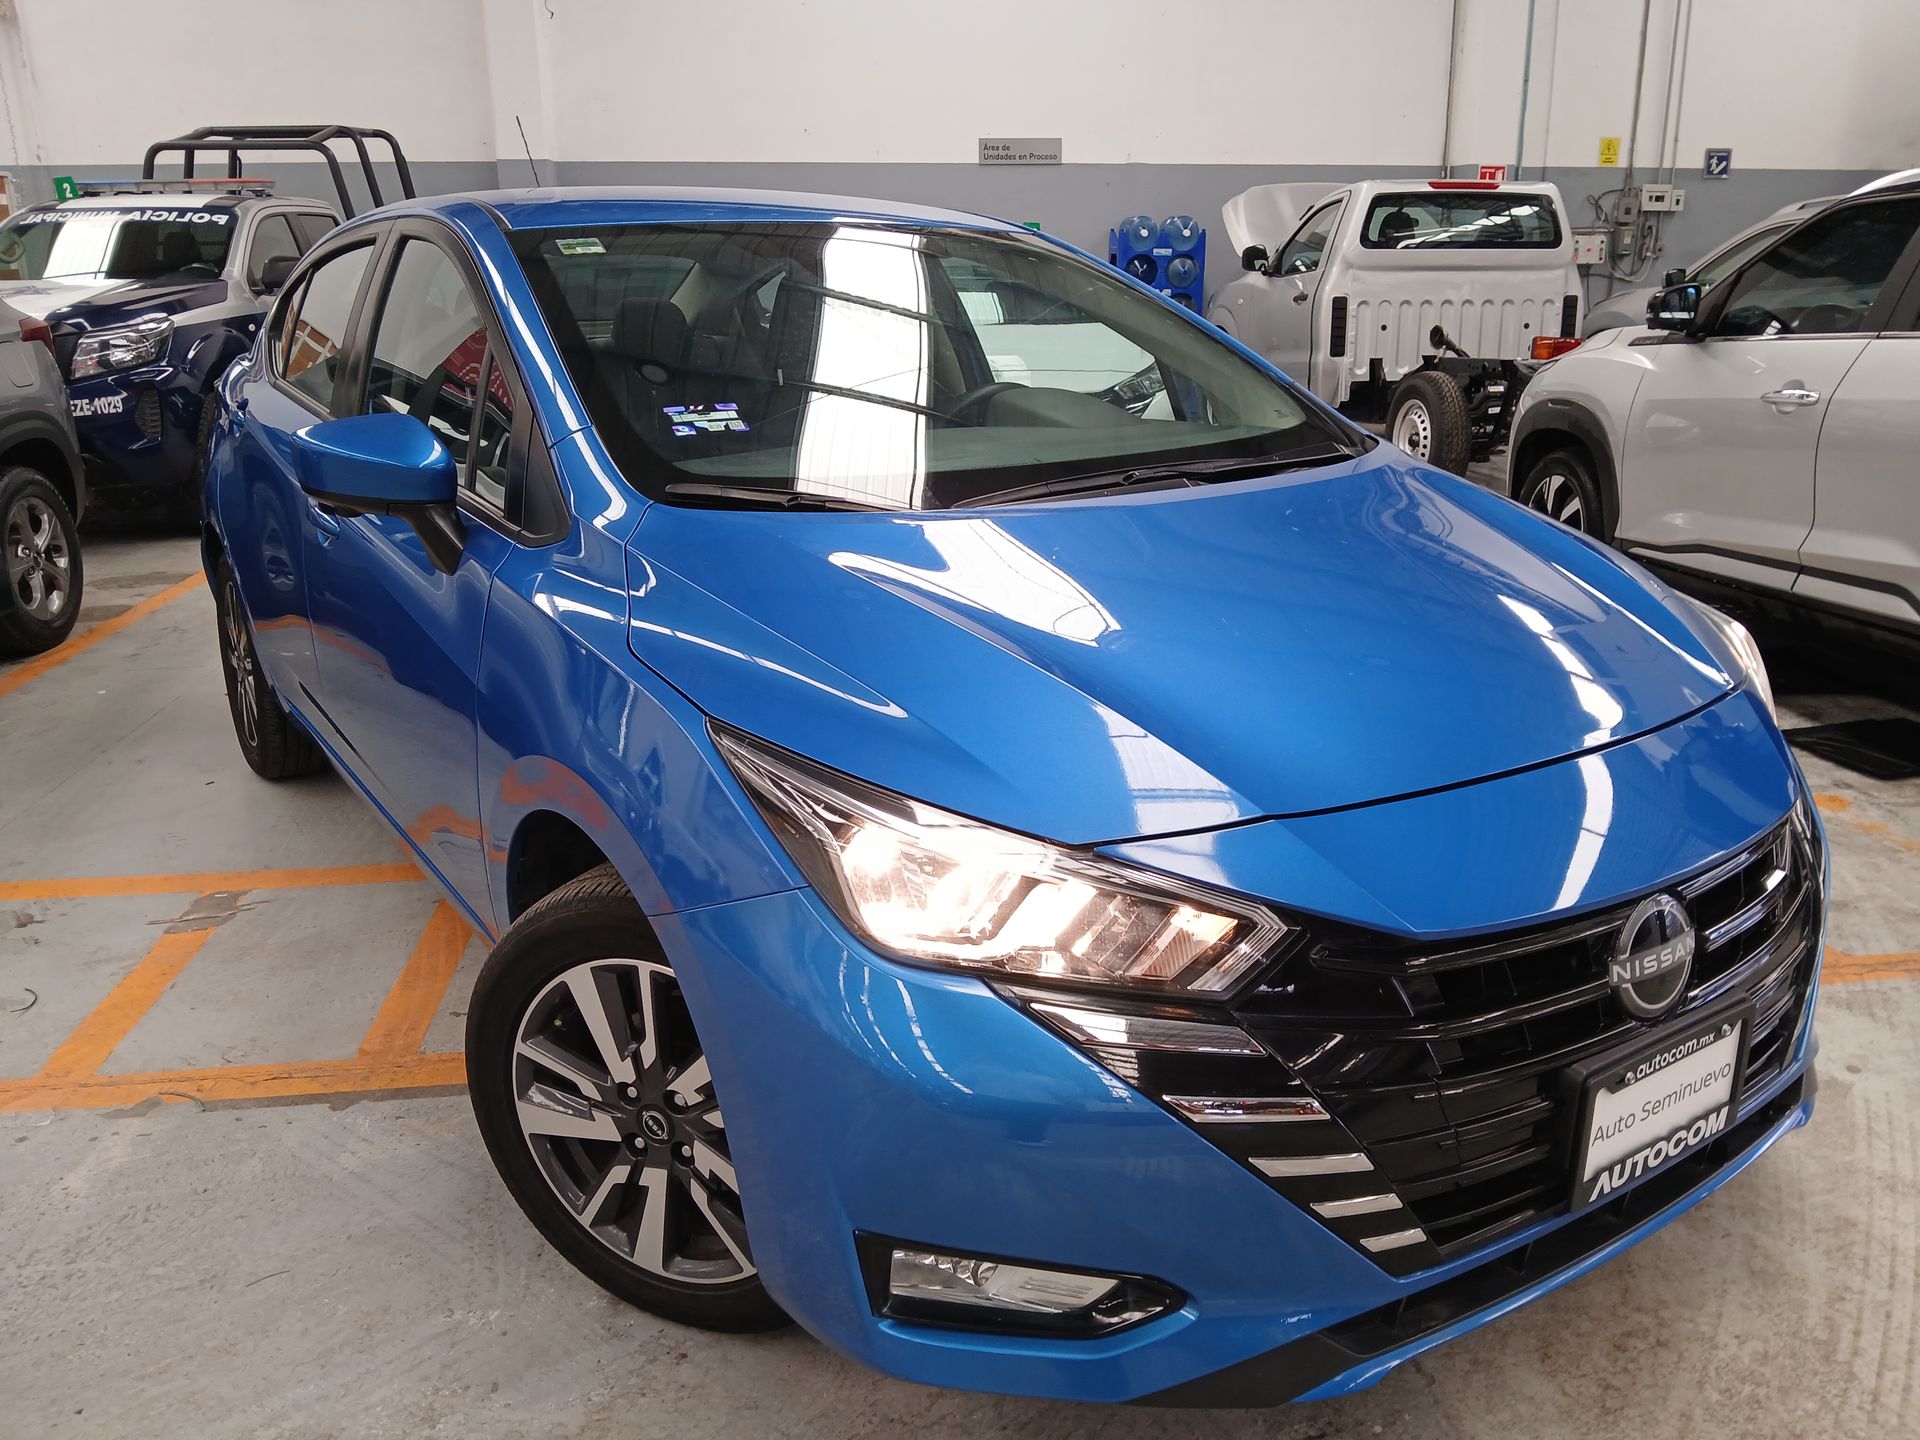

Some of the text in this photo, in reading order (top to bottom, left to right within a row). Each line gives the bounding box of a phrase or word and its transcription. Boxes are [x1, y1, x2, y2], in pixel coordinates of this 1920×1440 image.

[983, 141, 1011, 151] Área de
[983, 152, 1016, 161] Unidades
[1029, 152, 1058, 161] Proceso
[63, 182, 73, 198] 2
[1612, 935, 1694, 983] NISSAN
[1636, 1031, 1716, 1078] autocom.mx
[1591, 1062, 1731, 1148] Auto Seminuevo
[1588, 1105, 1730, 1203] AUTOCOM
